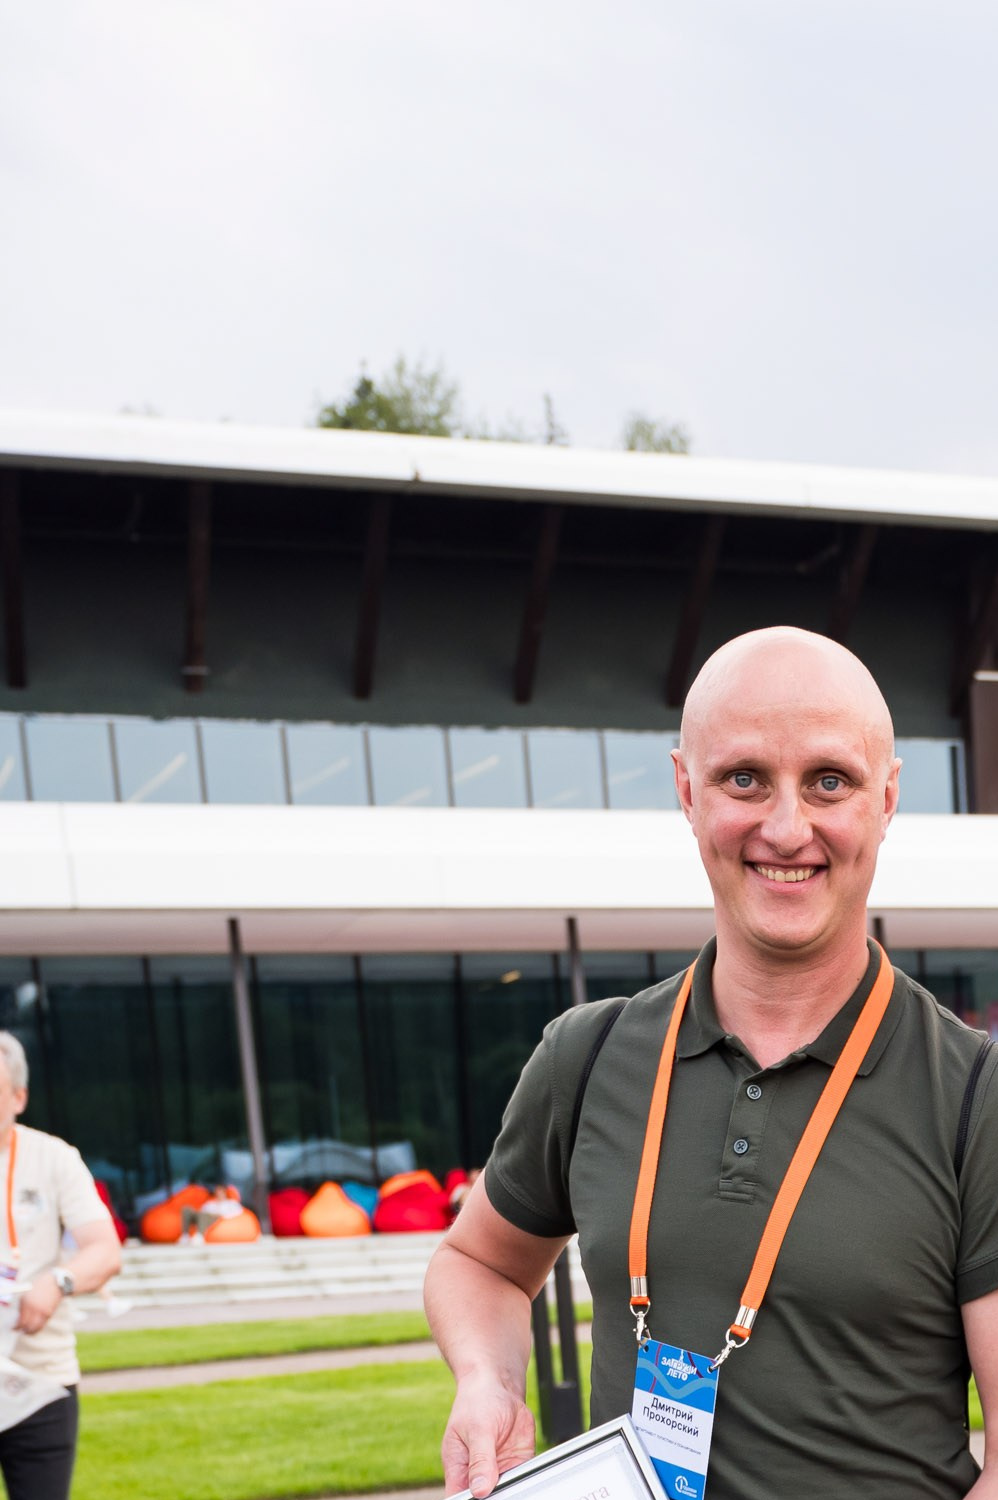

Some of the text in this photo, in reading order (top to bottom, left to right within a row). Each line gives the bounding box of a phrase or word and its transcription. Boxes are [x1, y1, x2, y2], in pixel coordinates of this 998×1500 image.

[667, 1366, 688, 1381] ЛЕТО
[643, 1406, 699, 1437] Прохорский
[651, 1397, 693, 1422] Дмитрий
